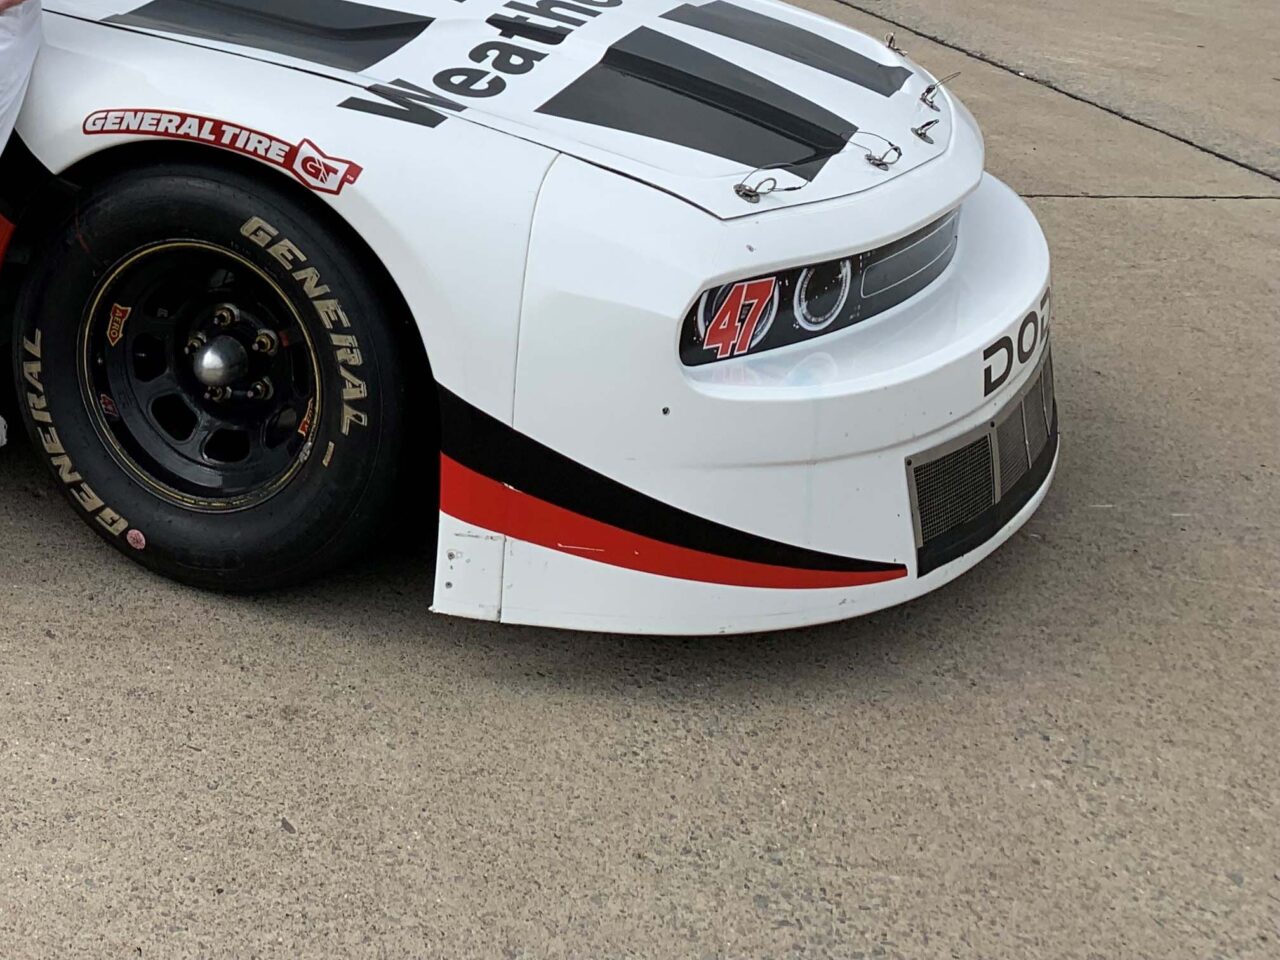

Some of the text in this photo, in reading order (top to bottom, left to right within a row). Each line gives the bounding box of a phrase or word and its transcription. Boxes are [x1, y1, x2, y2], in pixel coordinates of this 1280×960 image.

[84, 111, 340, 186] GENERAL TIRE GT
[111, 309, 122, 337] AERO
[239, 216, 368, 436] GENERAL
[703, 276, 777, 359] 47
[22, 327, 130, 537] GENERAL
